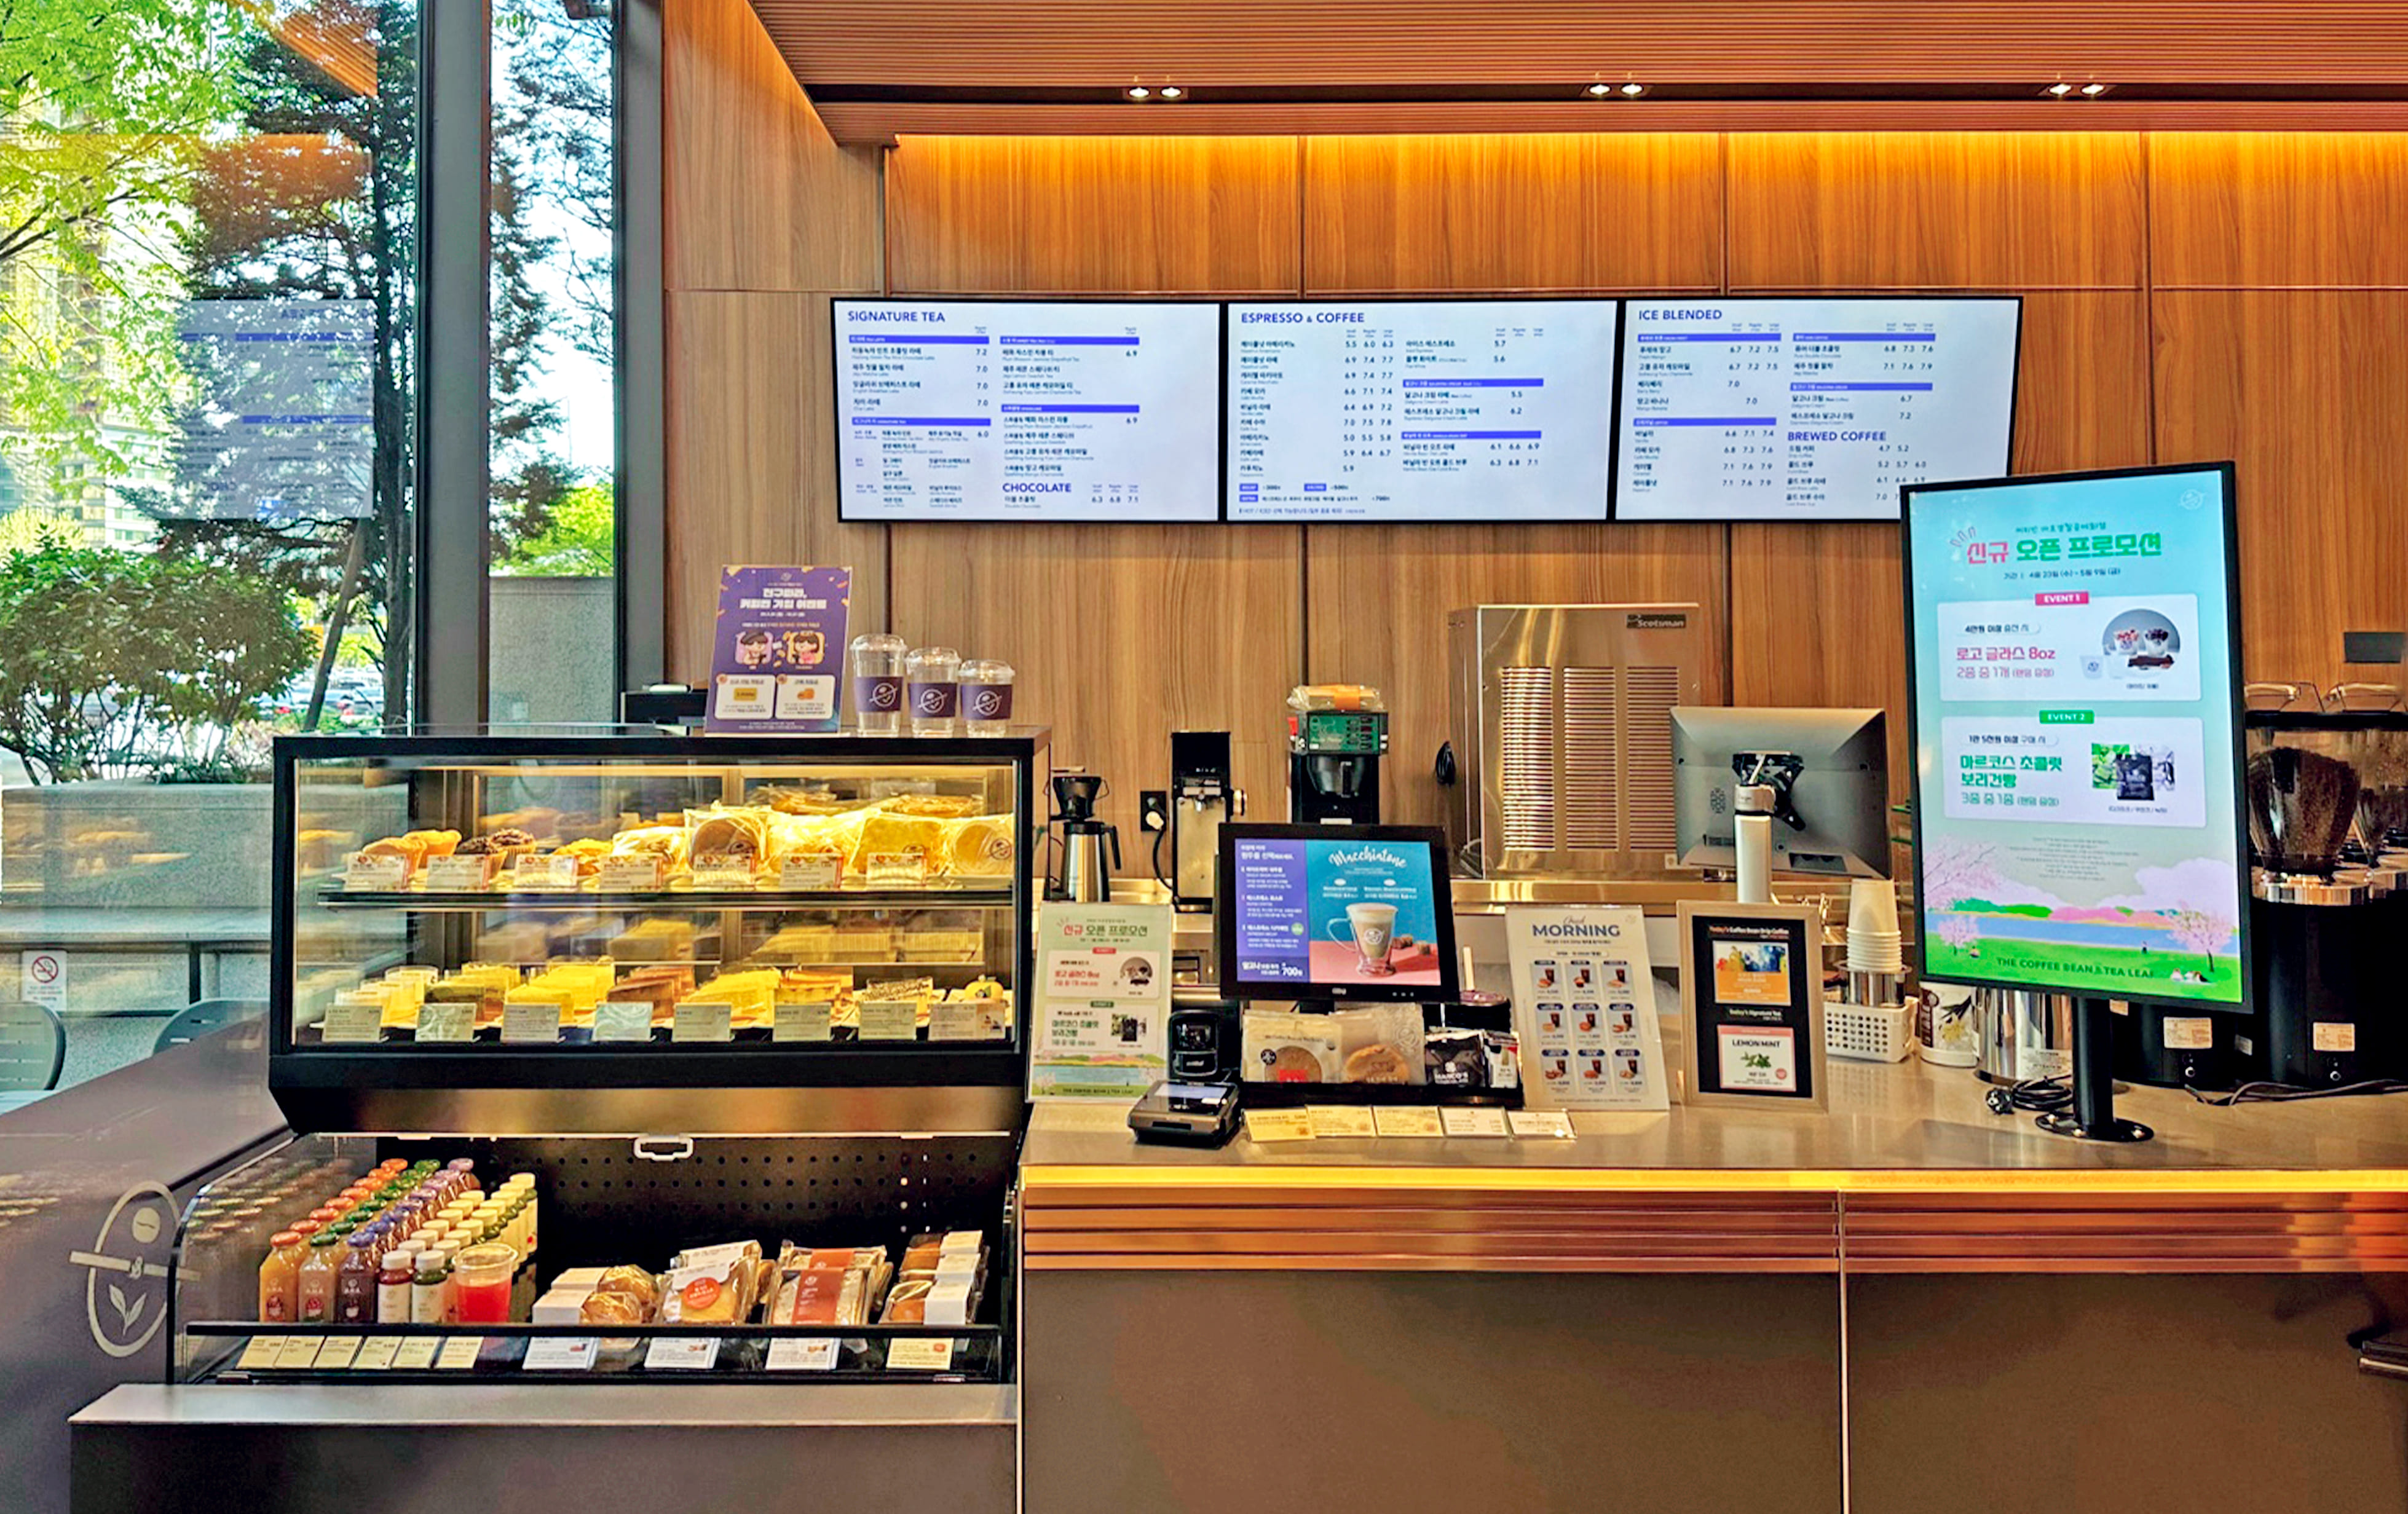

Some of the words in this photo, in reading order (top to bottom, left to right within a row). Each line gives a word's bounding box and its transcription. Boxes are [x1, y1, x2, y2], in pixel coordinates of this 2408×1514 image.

[848, 311, 917, 321] SIGNATURE
[922, 312, 945, 322] TEA
[1242, 313, 1303, 323] ESPRESSO
[1316, 313, 1364, 323] COFFEE
[1639, 310, 1658, 320] ICE
[1663, 310, 1722, 320] BLENDED
[1788, 432, 1838, 441] BREWED
[1841, 432, 1885, 441] COFFEE
[1003, 483, 1071, 492] CHOCOLATE
[1967, 542, 2008, 564] 신규
[2016, 538, 2061, 561] 오픈
[2067, 531, 2161, 559] 프로모션
[2043, 594, 2074, 603] EVENT
[2075, 594, 2080, 602] 1
[1957, 647, 1982, 661] 로고
[1986, 647, 2025, 661] 글라스
[2029, 647, 2055, 660] 8oz
[1993, 666, 2010, 679] 1개
[1960, 755, 2015, 770] 마르코스
[2020, 755, 2062, 771] 초콜릿
[1962, 773, 2016, 788] 보리건빵
[1532, 925, 1620, 936] MORNING
[1997, 957, 2016, 967] THE
[2019, 959, 2059, 971] COFFEE
[2063, 963, 2093, 973] BEAN
[2104, 966, 2125, 977] TEA
[2128, 968, 2154, 978] LEAF
